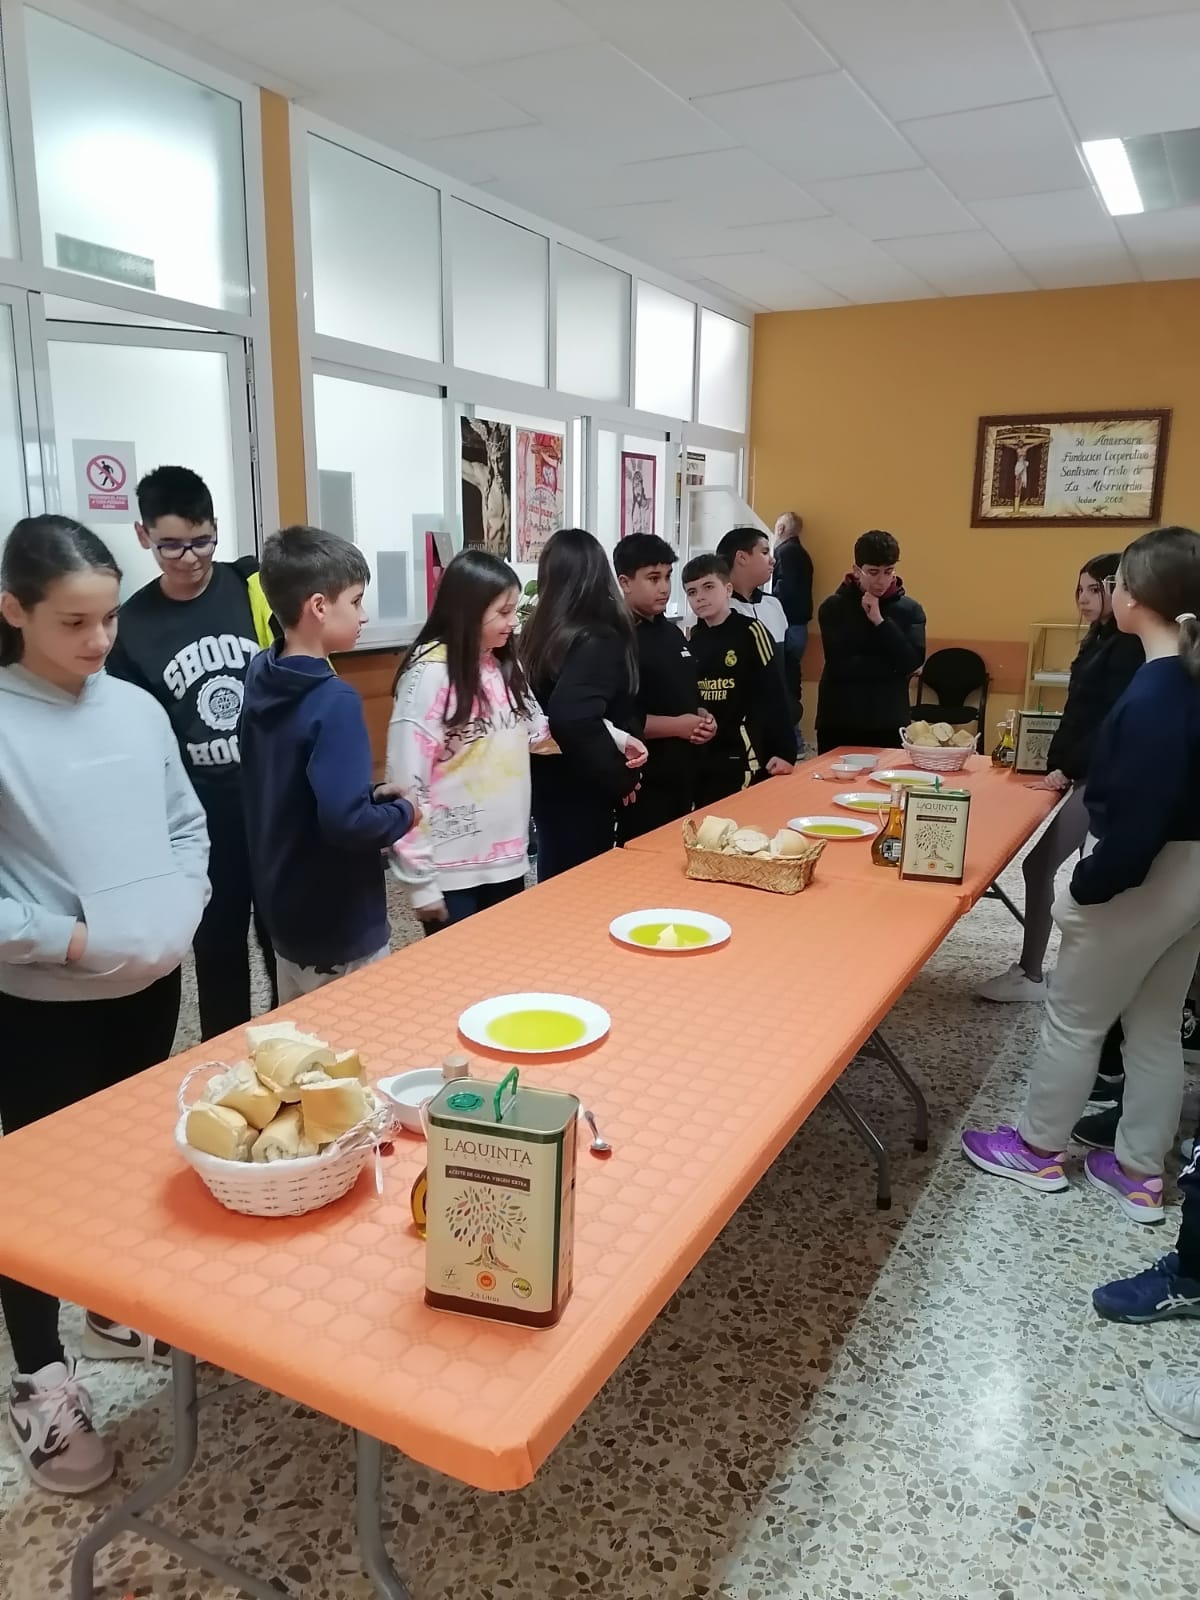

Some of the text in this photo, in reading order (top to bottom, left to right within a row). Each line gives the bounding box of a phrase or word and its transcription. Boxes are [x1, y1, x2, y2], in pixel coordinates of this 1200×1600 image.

[916, 802, 959, 812] LAQUINTA
[444, 1137, 533, 1166] LAQUINTA
[448, 1168, 466, 1177] ACEITE
